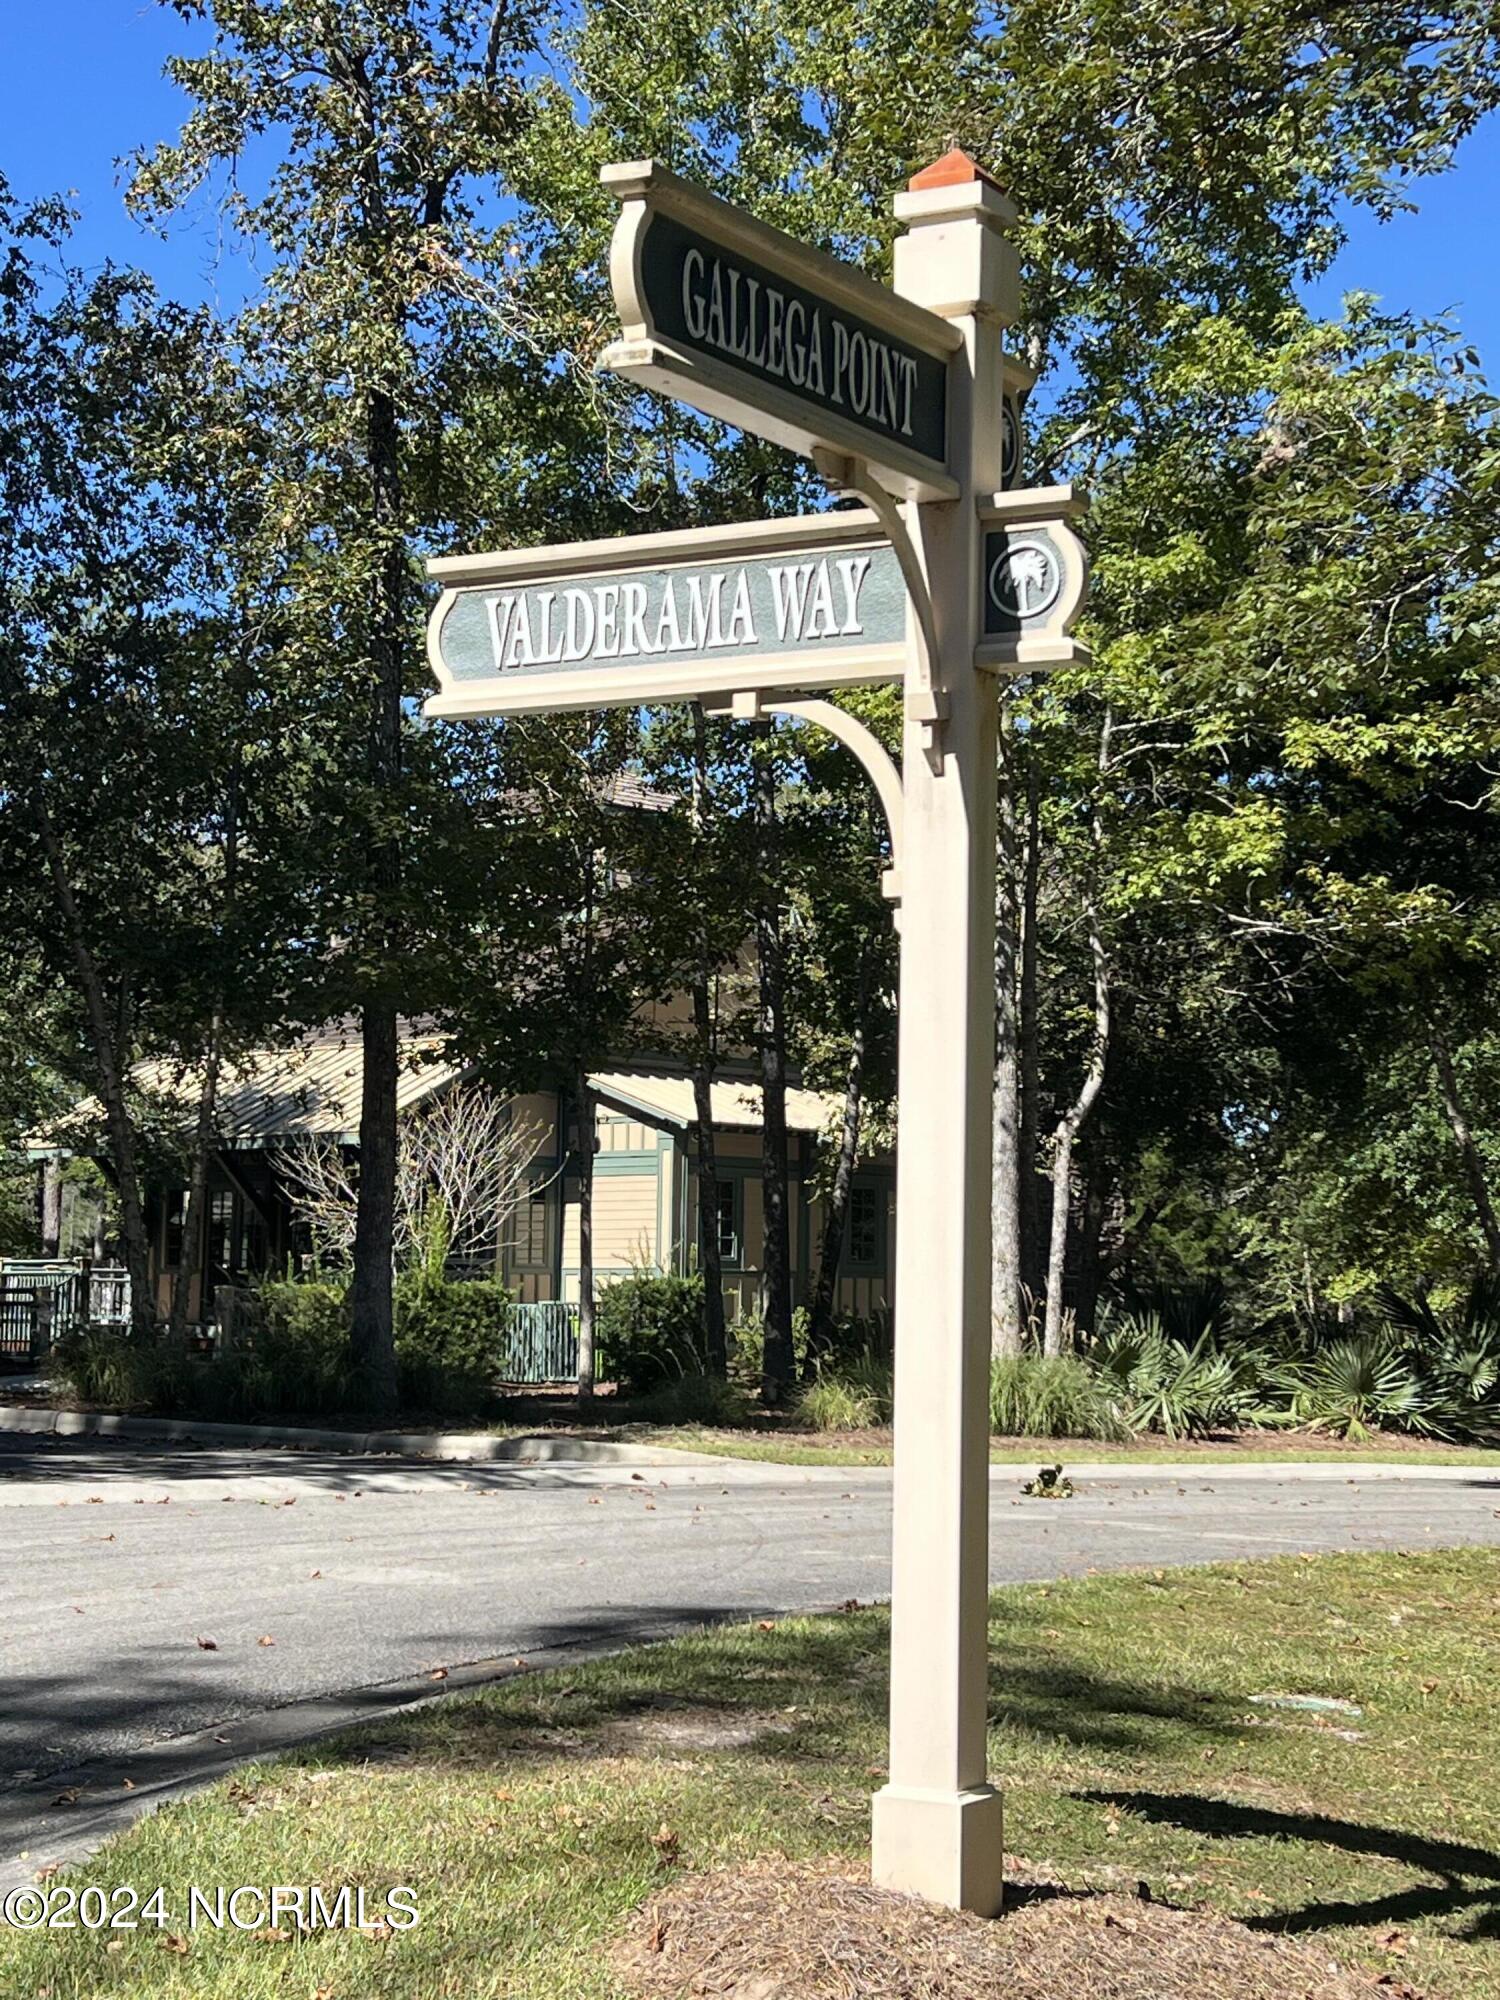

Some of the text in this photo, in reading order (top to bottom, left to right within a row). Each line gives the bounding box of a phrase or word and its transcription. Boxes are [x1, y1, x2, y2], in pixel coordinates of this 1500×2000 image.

[682, 248, 918, 436] GALLEGA POINT
[485, 557, 871, 669] VALDERAMA WAY
